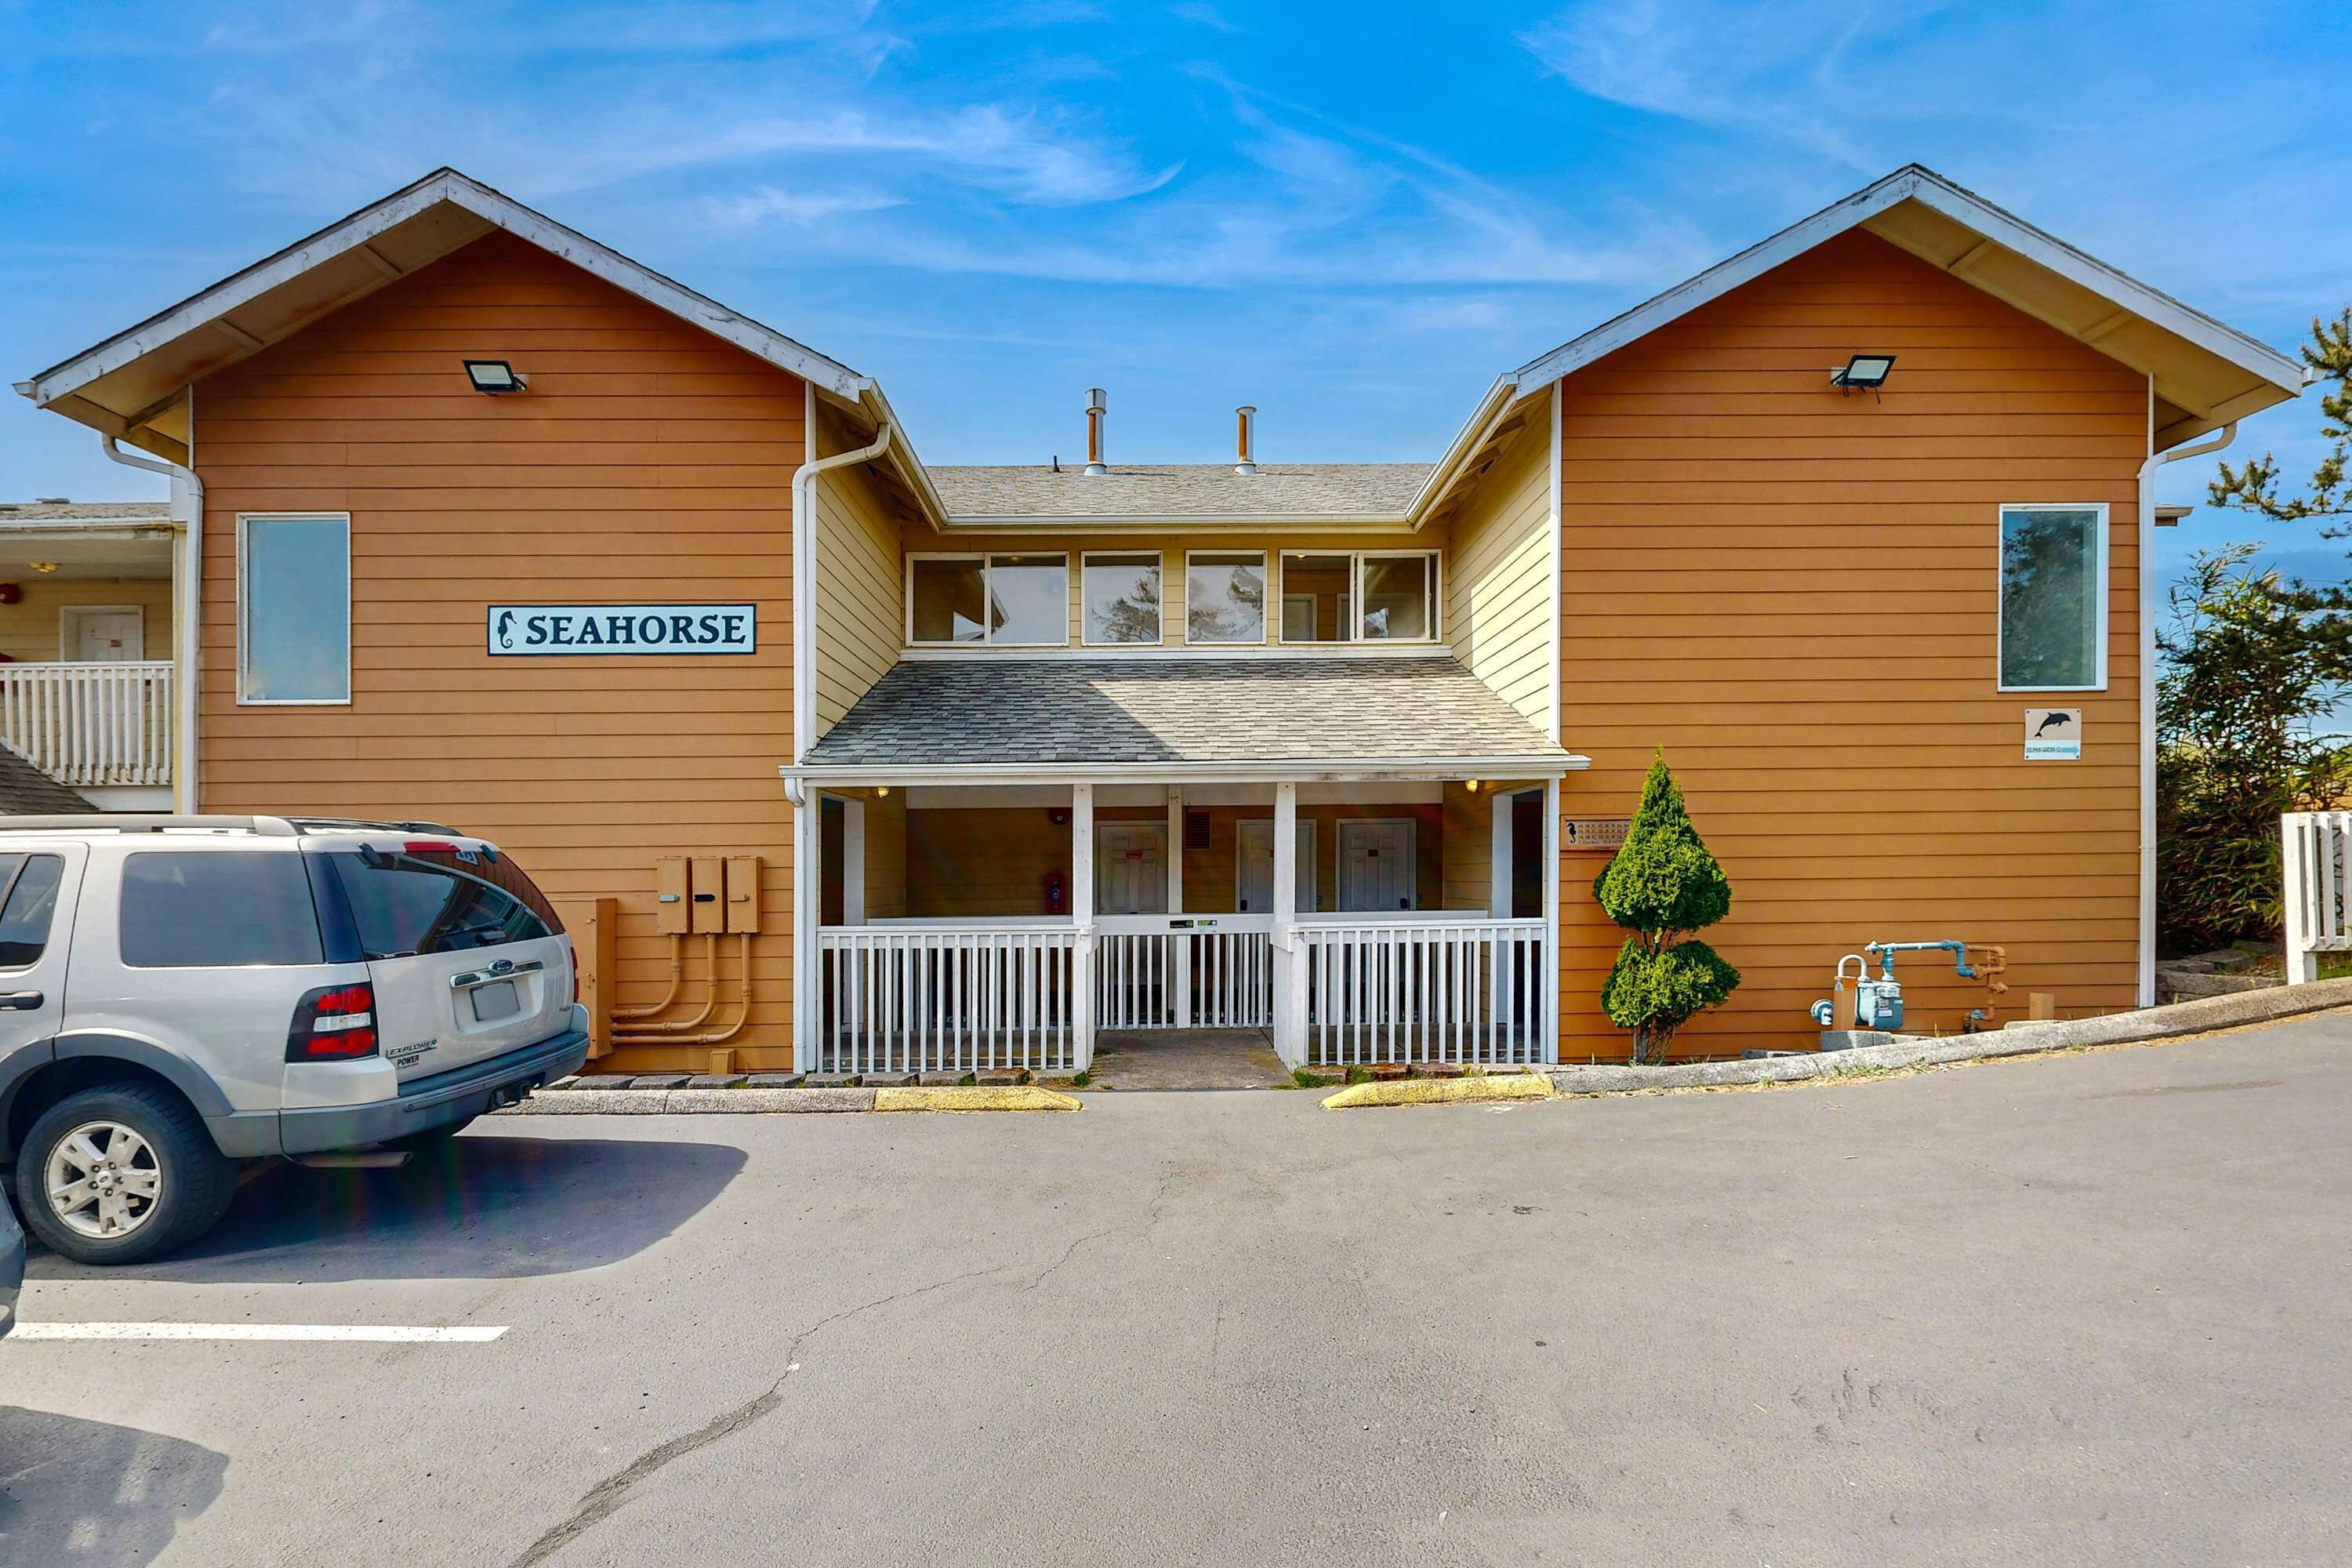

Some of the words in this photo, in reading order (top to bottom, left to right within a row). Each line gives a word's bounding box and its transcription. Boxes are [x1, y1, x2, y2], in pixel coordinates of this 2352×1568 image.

[525, 614, 746, 645] SEAHORSE
[390, 1039, 437, 1055] EXPLORER
[397, 1054, 419, 1067] POWER
